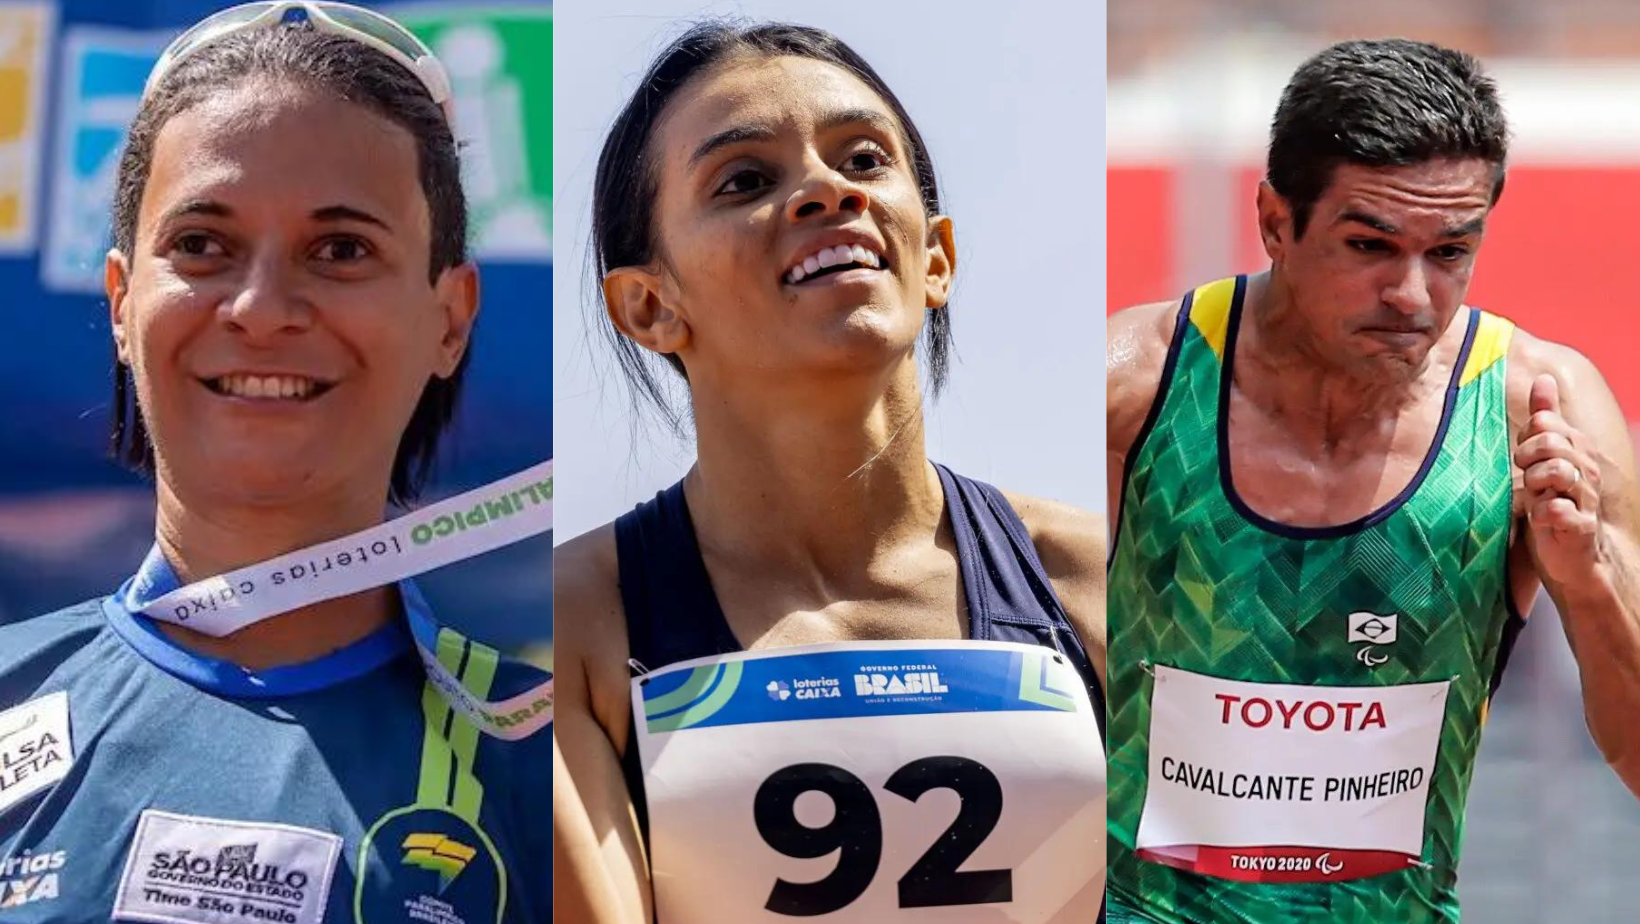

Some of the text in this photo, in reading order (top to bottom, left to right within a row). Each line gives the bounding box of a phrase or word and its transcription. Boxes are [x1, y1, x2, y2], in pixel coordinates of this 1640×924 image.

[271, 536, 402, 586] loterias
[175, 580, 255, 621] caixa
[793, 676, 840, 689] loterias
[795, 687, 841, 700] CAIXA
[853, 672, 949, 696] BRASIL
[1215, 693, 1387, 731] TOYOTA
[0, 732, 59, 770] LSA
[1161, 756, 1424, 801] CAVALCANTE PINHEIRO
[753, 755, 1013, 917] 92
[151, 850, 308, 889] SÃO PAULO
[1230, 854, 1311, 871] TOKYO 2020
[147, 869, 304, 901] GOVERNO DO ESTADO
[143, 889, 296, 924] Time São Paulo
